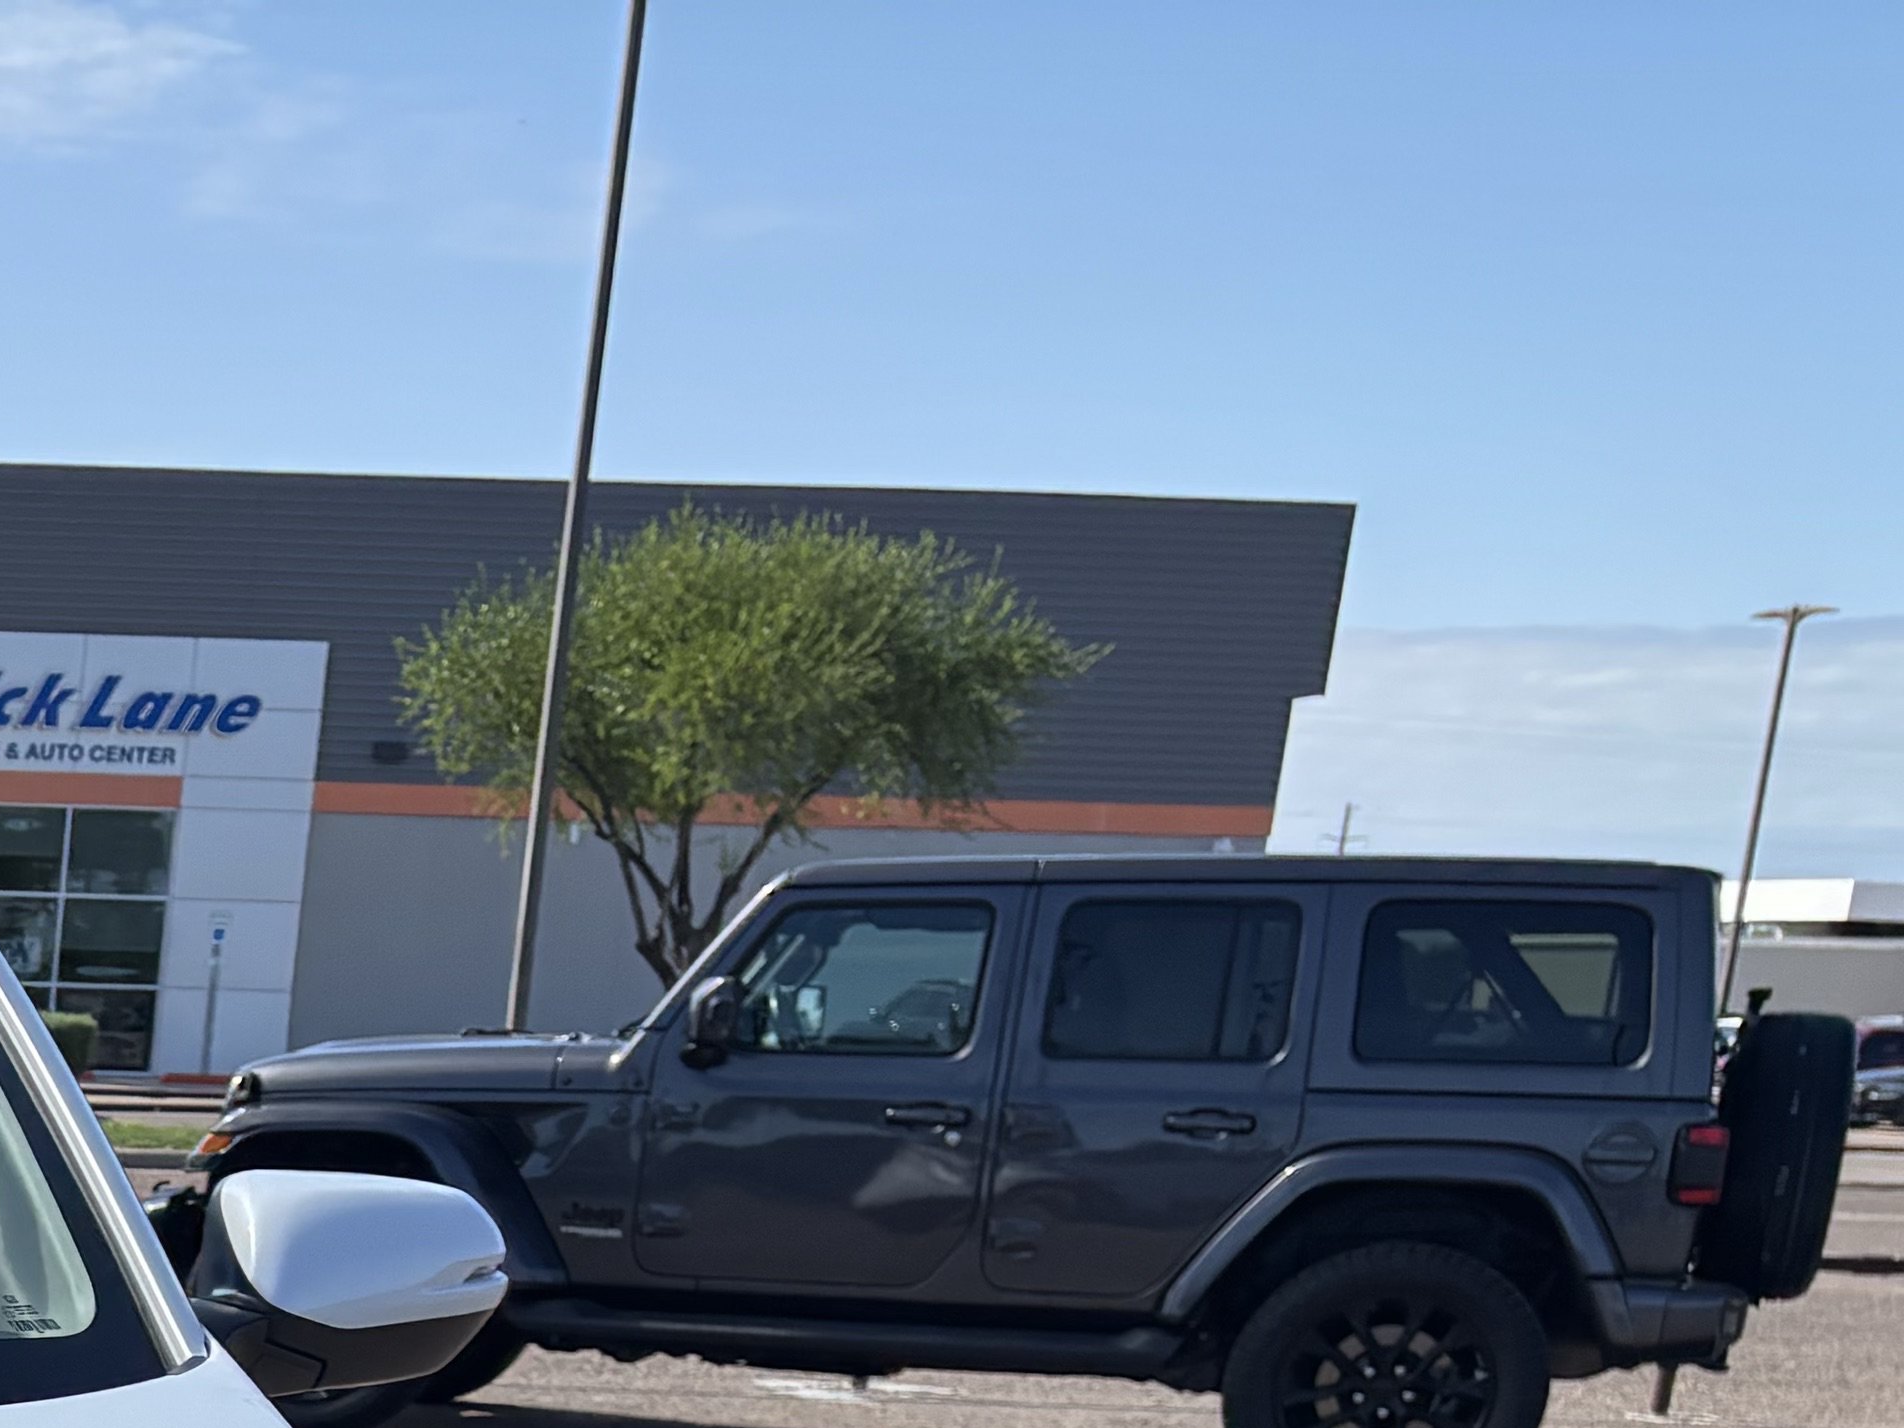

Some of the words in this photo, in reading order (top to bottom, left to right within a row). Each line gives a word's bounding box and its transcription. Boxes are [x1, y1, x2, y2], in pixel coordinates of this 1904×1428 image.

[80, 674, 263, 735] Lane
[5, 742, 18, 761] &
[26, 742, 84, 763] AUTO
[89, 744, 176, 766] CENTER
